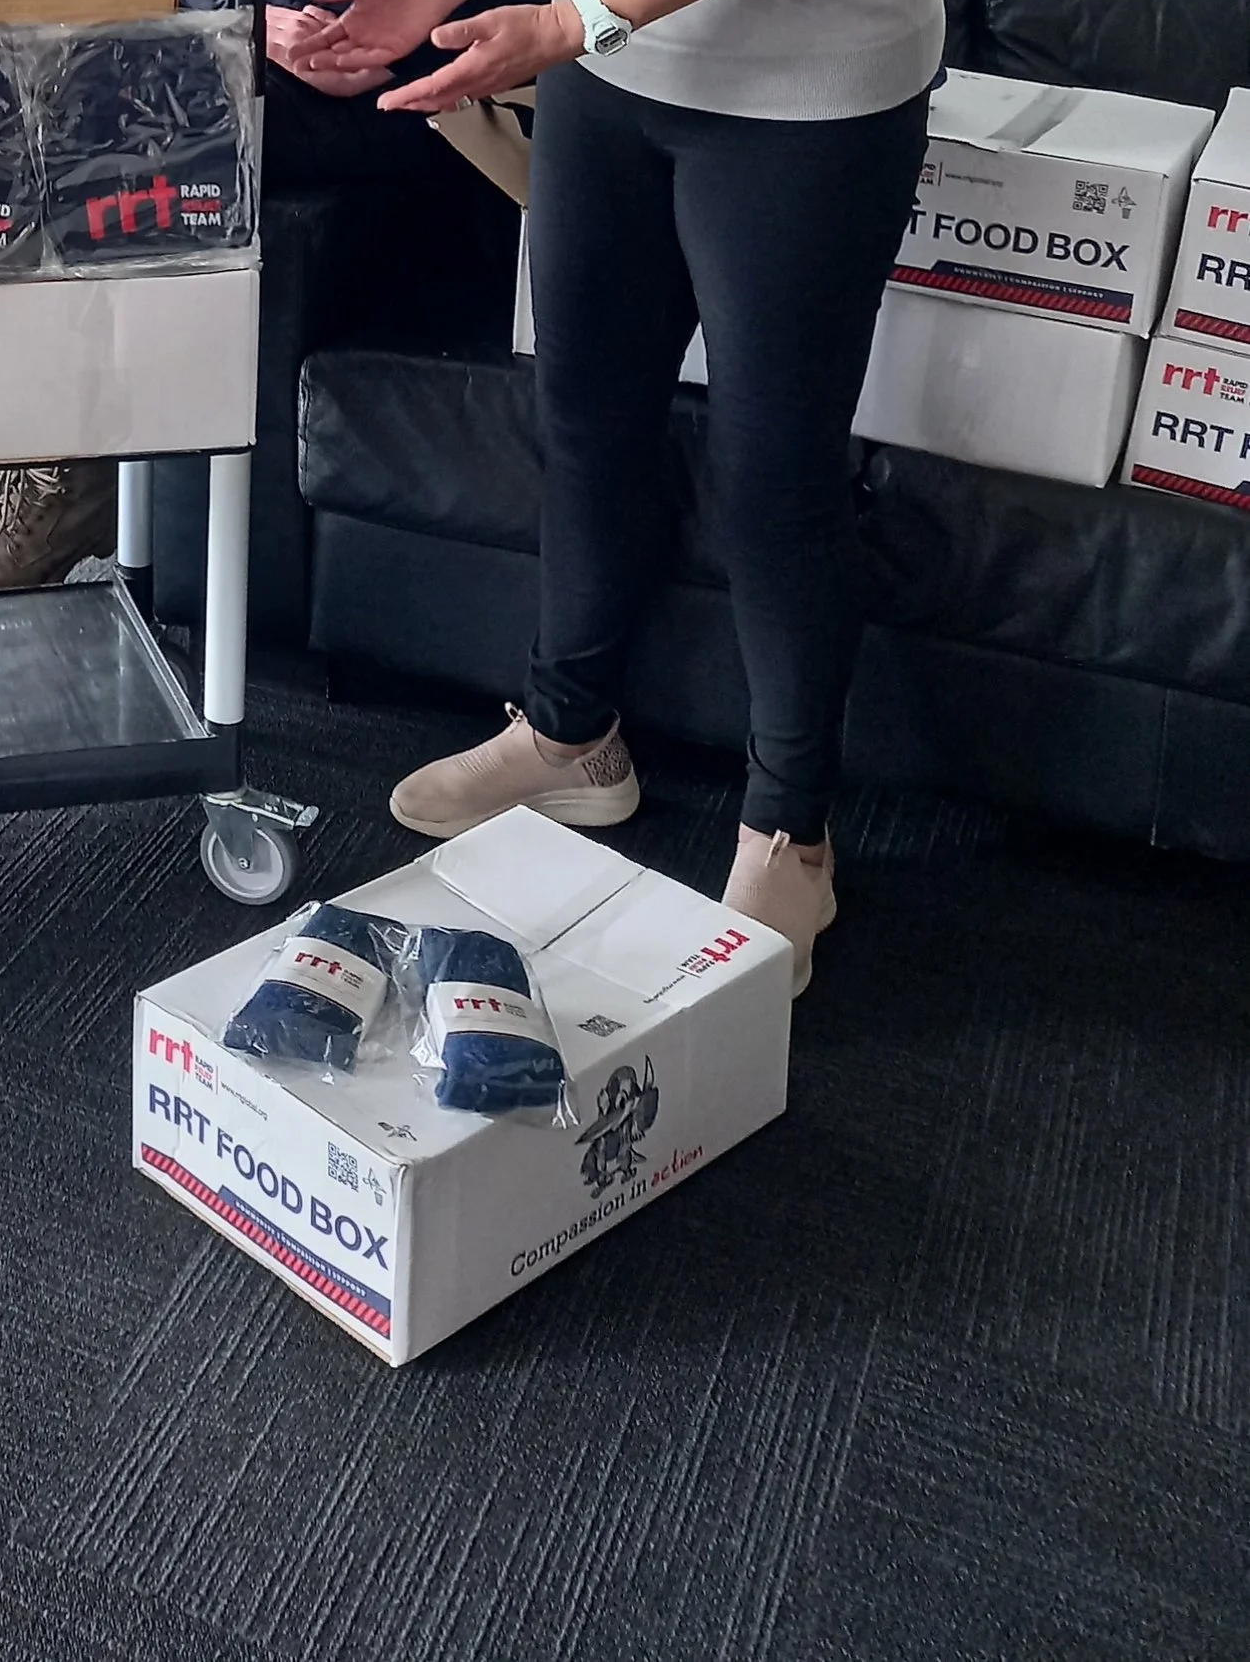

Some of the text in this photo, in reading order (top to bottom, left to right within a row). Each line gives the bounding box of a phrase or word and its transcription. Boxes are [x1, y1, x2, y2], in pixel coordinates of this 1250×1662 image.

[86, 174, 178, 240] rrt
[180, 184, 222, 198] RAPID
[180, 212, 222, 227] TEAM
[932, 212, 1040, 255] FOOD
[1046, 232, 1132, 273] BOX
[1162, 363, 1221, 396] rrt
[1222, 377, 1249, 389] RAPID
[1220, 392, 1245, 404] TEAM
[1152, 410, 1235, 453] RRT
[700, 928, 751, 963] rrt
[294, 951, 343, 975] rrt
[453, 997, 502, 1013] rrt
[149, 1027, 193, 1074] rrt
[149, 1083, 389, 1271] RRT FOOD BOX
[510, 1144, 704, 1277] Compassion in action
